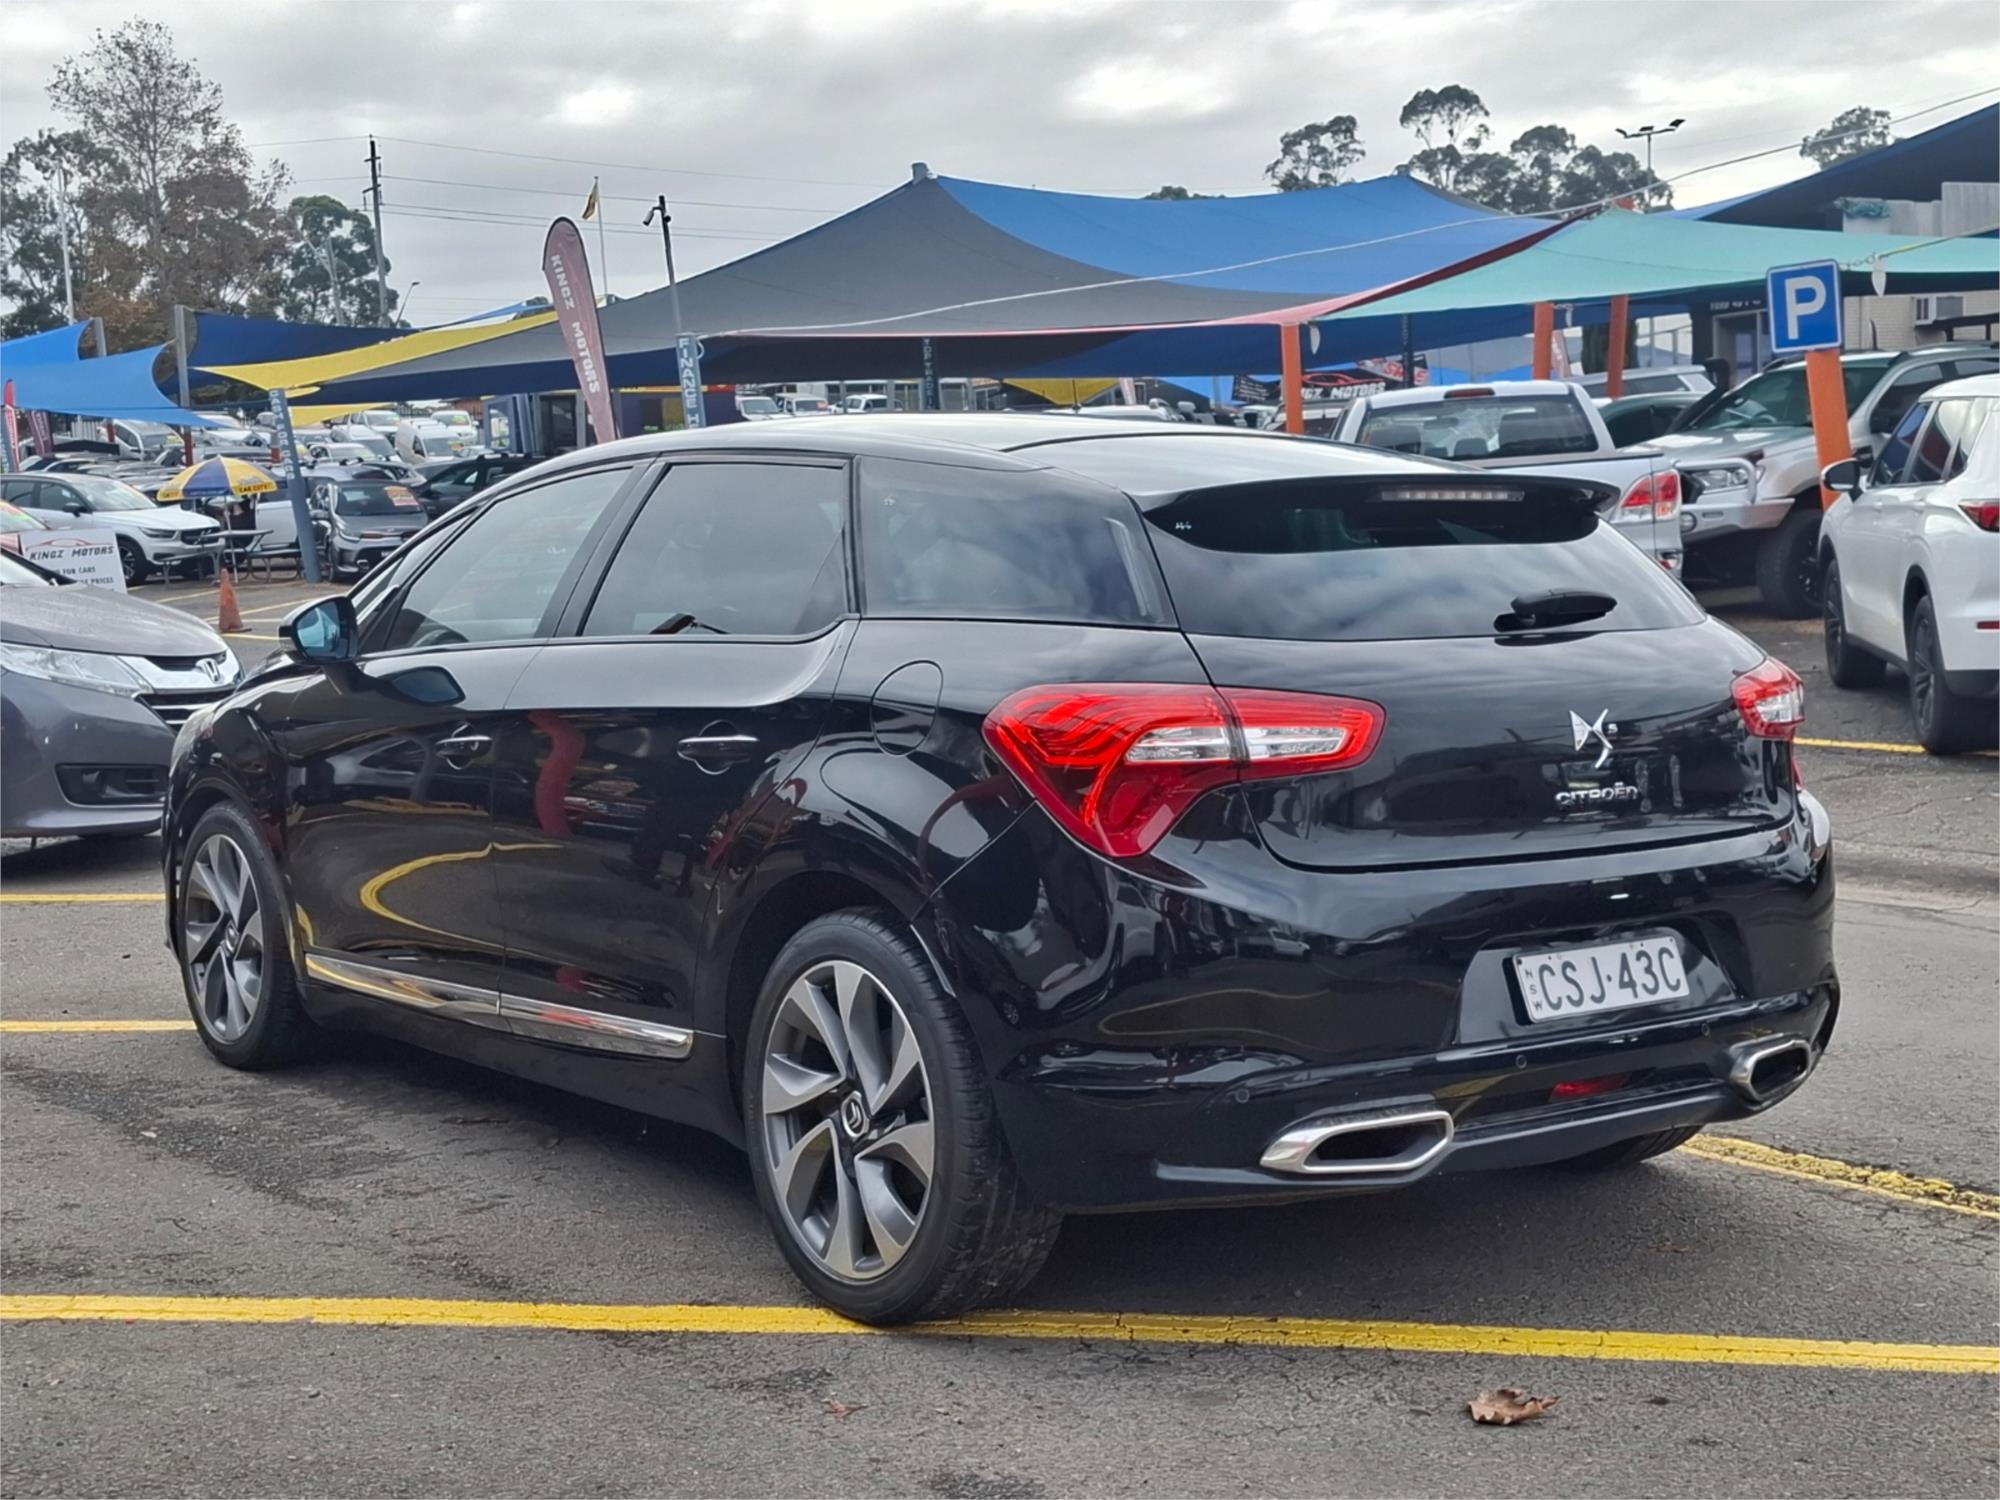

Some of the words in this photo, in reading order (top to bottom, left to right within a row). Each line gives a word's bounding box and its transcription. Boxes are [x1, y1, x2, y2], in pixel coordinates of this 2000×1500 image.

[551, 254, 576, 310] KINGZ
[571, 321, 601, 394] MOTORS
[1784, 275, 1827, 340] P
[679, 337, 698, 409] FINANCE
[1330, 381, 1387, 400] MOTORS
[29, 549, 65, 561] KINGZ
[71, 545, 115, 558] MOTORS
